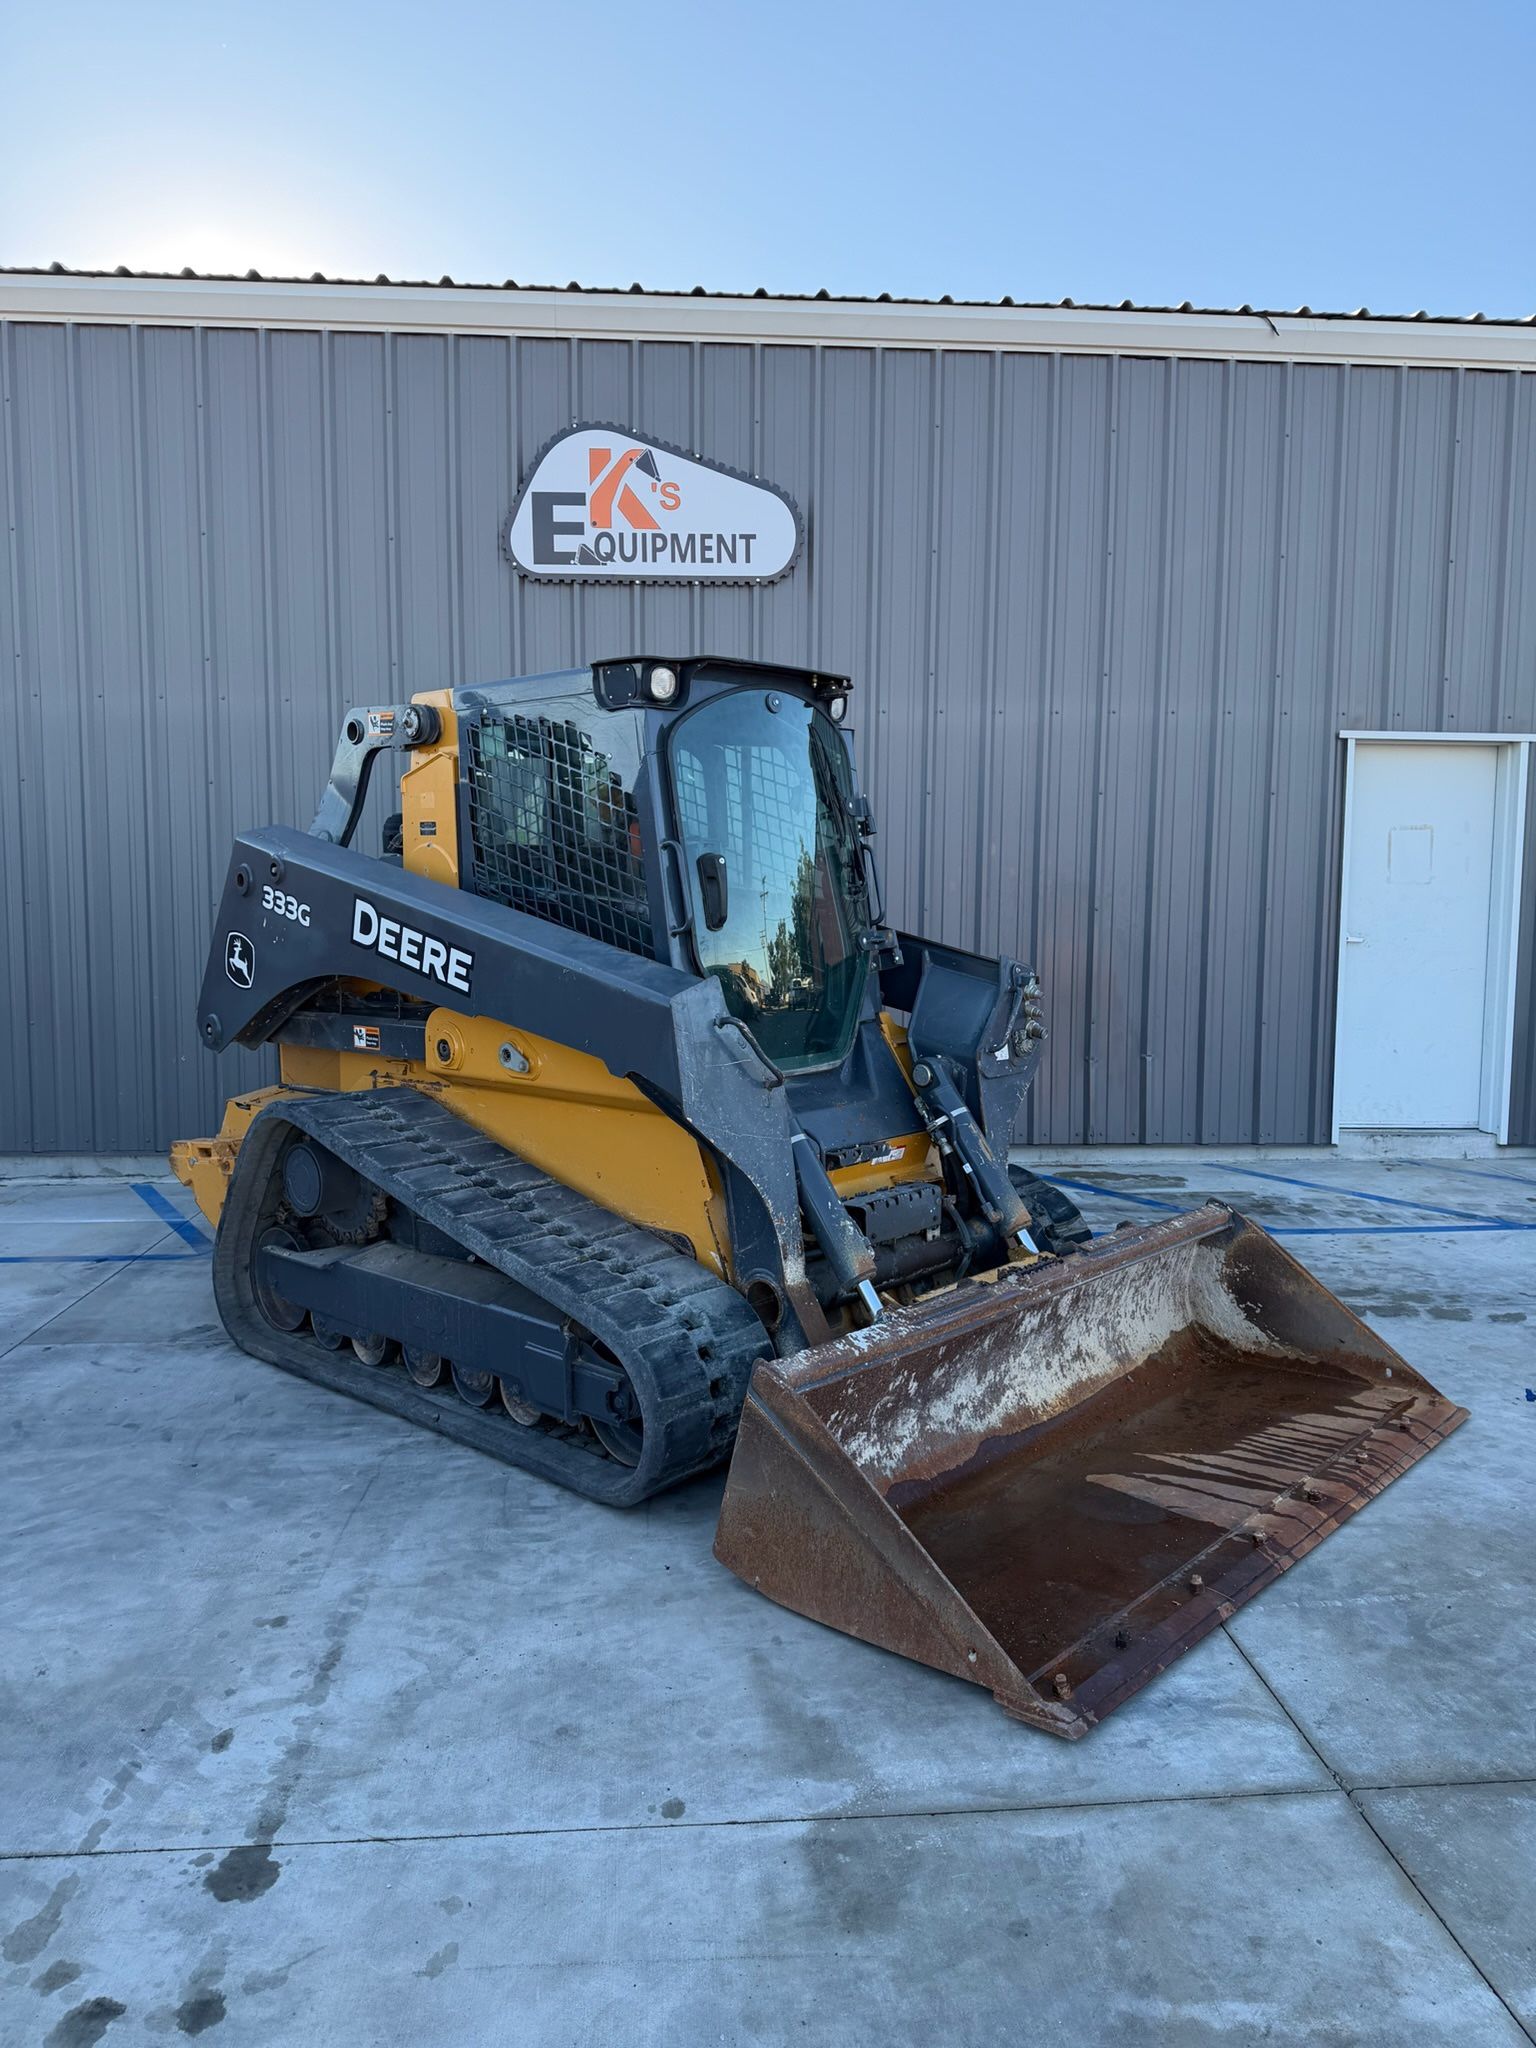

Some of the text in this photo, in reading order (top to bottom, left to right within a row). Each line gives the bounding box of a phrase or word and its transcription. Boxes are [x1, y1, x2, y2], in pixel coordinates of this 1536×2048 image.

[531, 492, 757, 565] EQUIPMENT
[262, 885, 311, 927] 333G
[352, 898, 472, 992] DEERE
